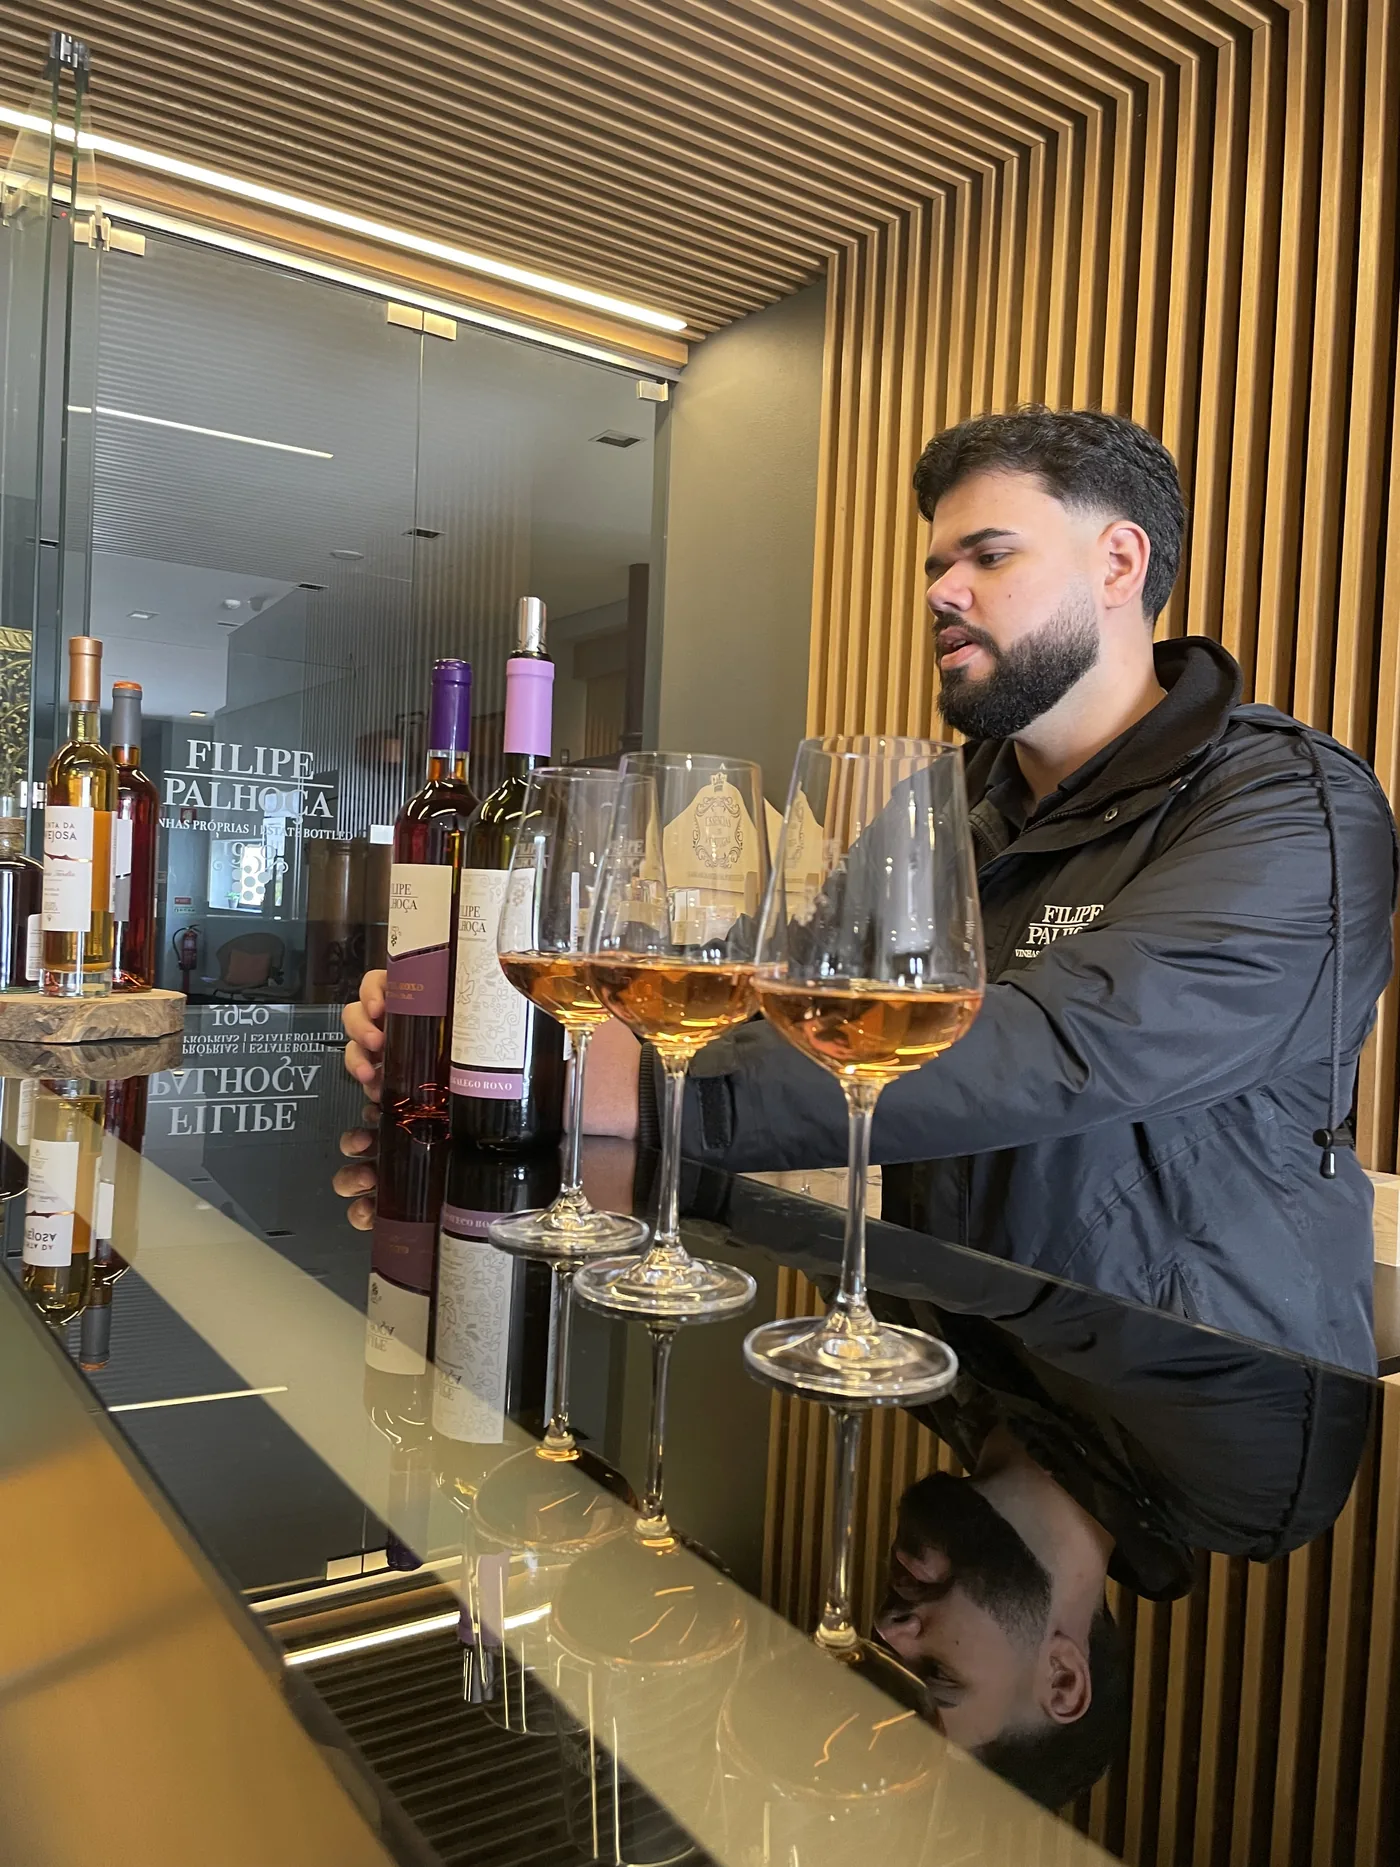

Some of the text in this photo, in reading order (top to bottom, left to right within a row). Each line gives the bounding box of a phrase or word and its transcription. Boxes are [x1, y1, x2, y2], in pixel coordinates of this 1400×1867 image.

[185, 739, 315, 781] FILIPE
[162, 777, 334, 825] PALHOÇA
[158, 818, 353, 841] NHAS PRÓPRIAS ESTATE BOTTLED
[45, 830, 77, 843] EJOSA
[391, 883, 412, 895] LIPE
[460, 905, 481, 918] LIPE
[483, 1081, 512, 1091] ROXO
